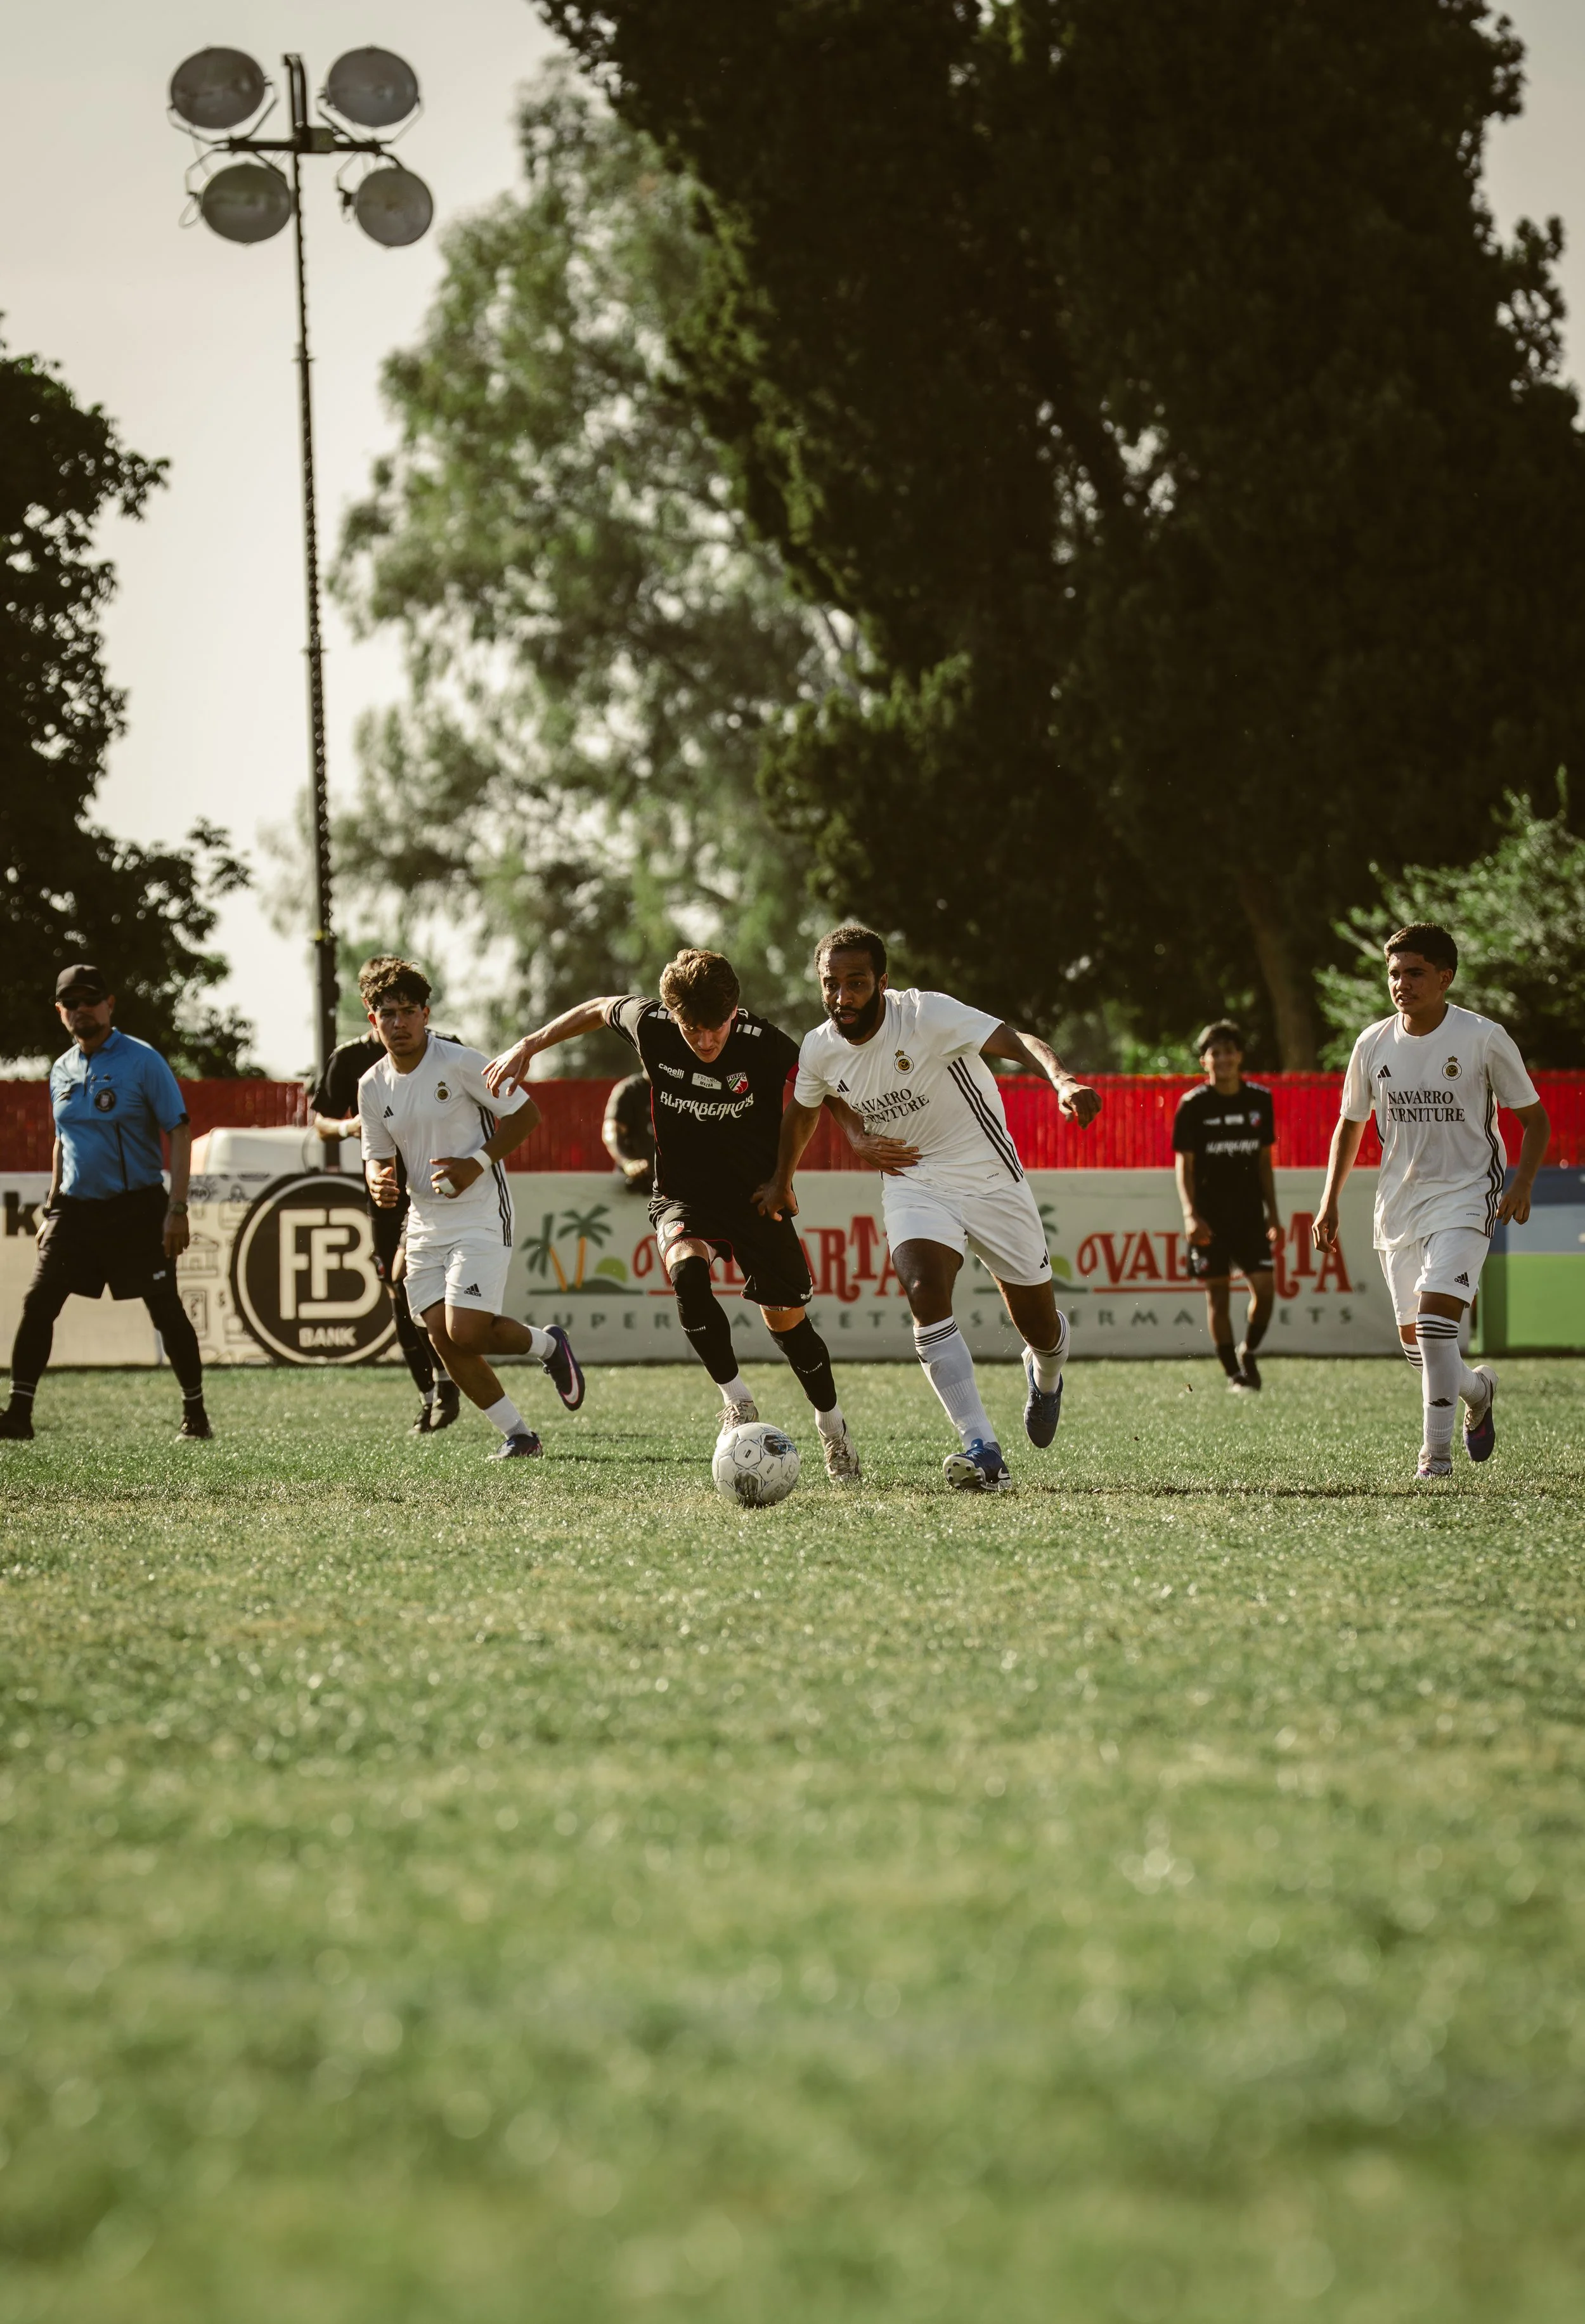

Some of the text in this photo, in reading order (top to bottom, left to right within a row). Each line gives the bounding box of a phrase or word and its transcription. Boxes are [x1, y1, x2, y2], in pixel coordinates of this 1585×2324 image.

[658, 1063, 684, 1077] capelli
[850, 1088, 912, 1114] NAVARRO
[1387, 1091, 1453, 1104] NAVARRO
[298, 1327, 357, 1347] BANK
